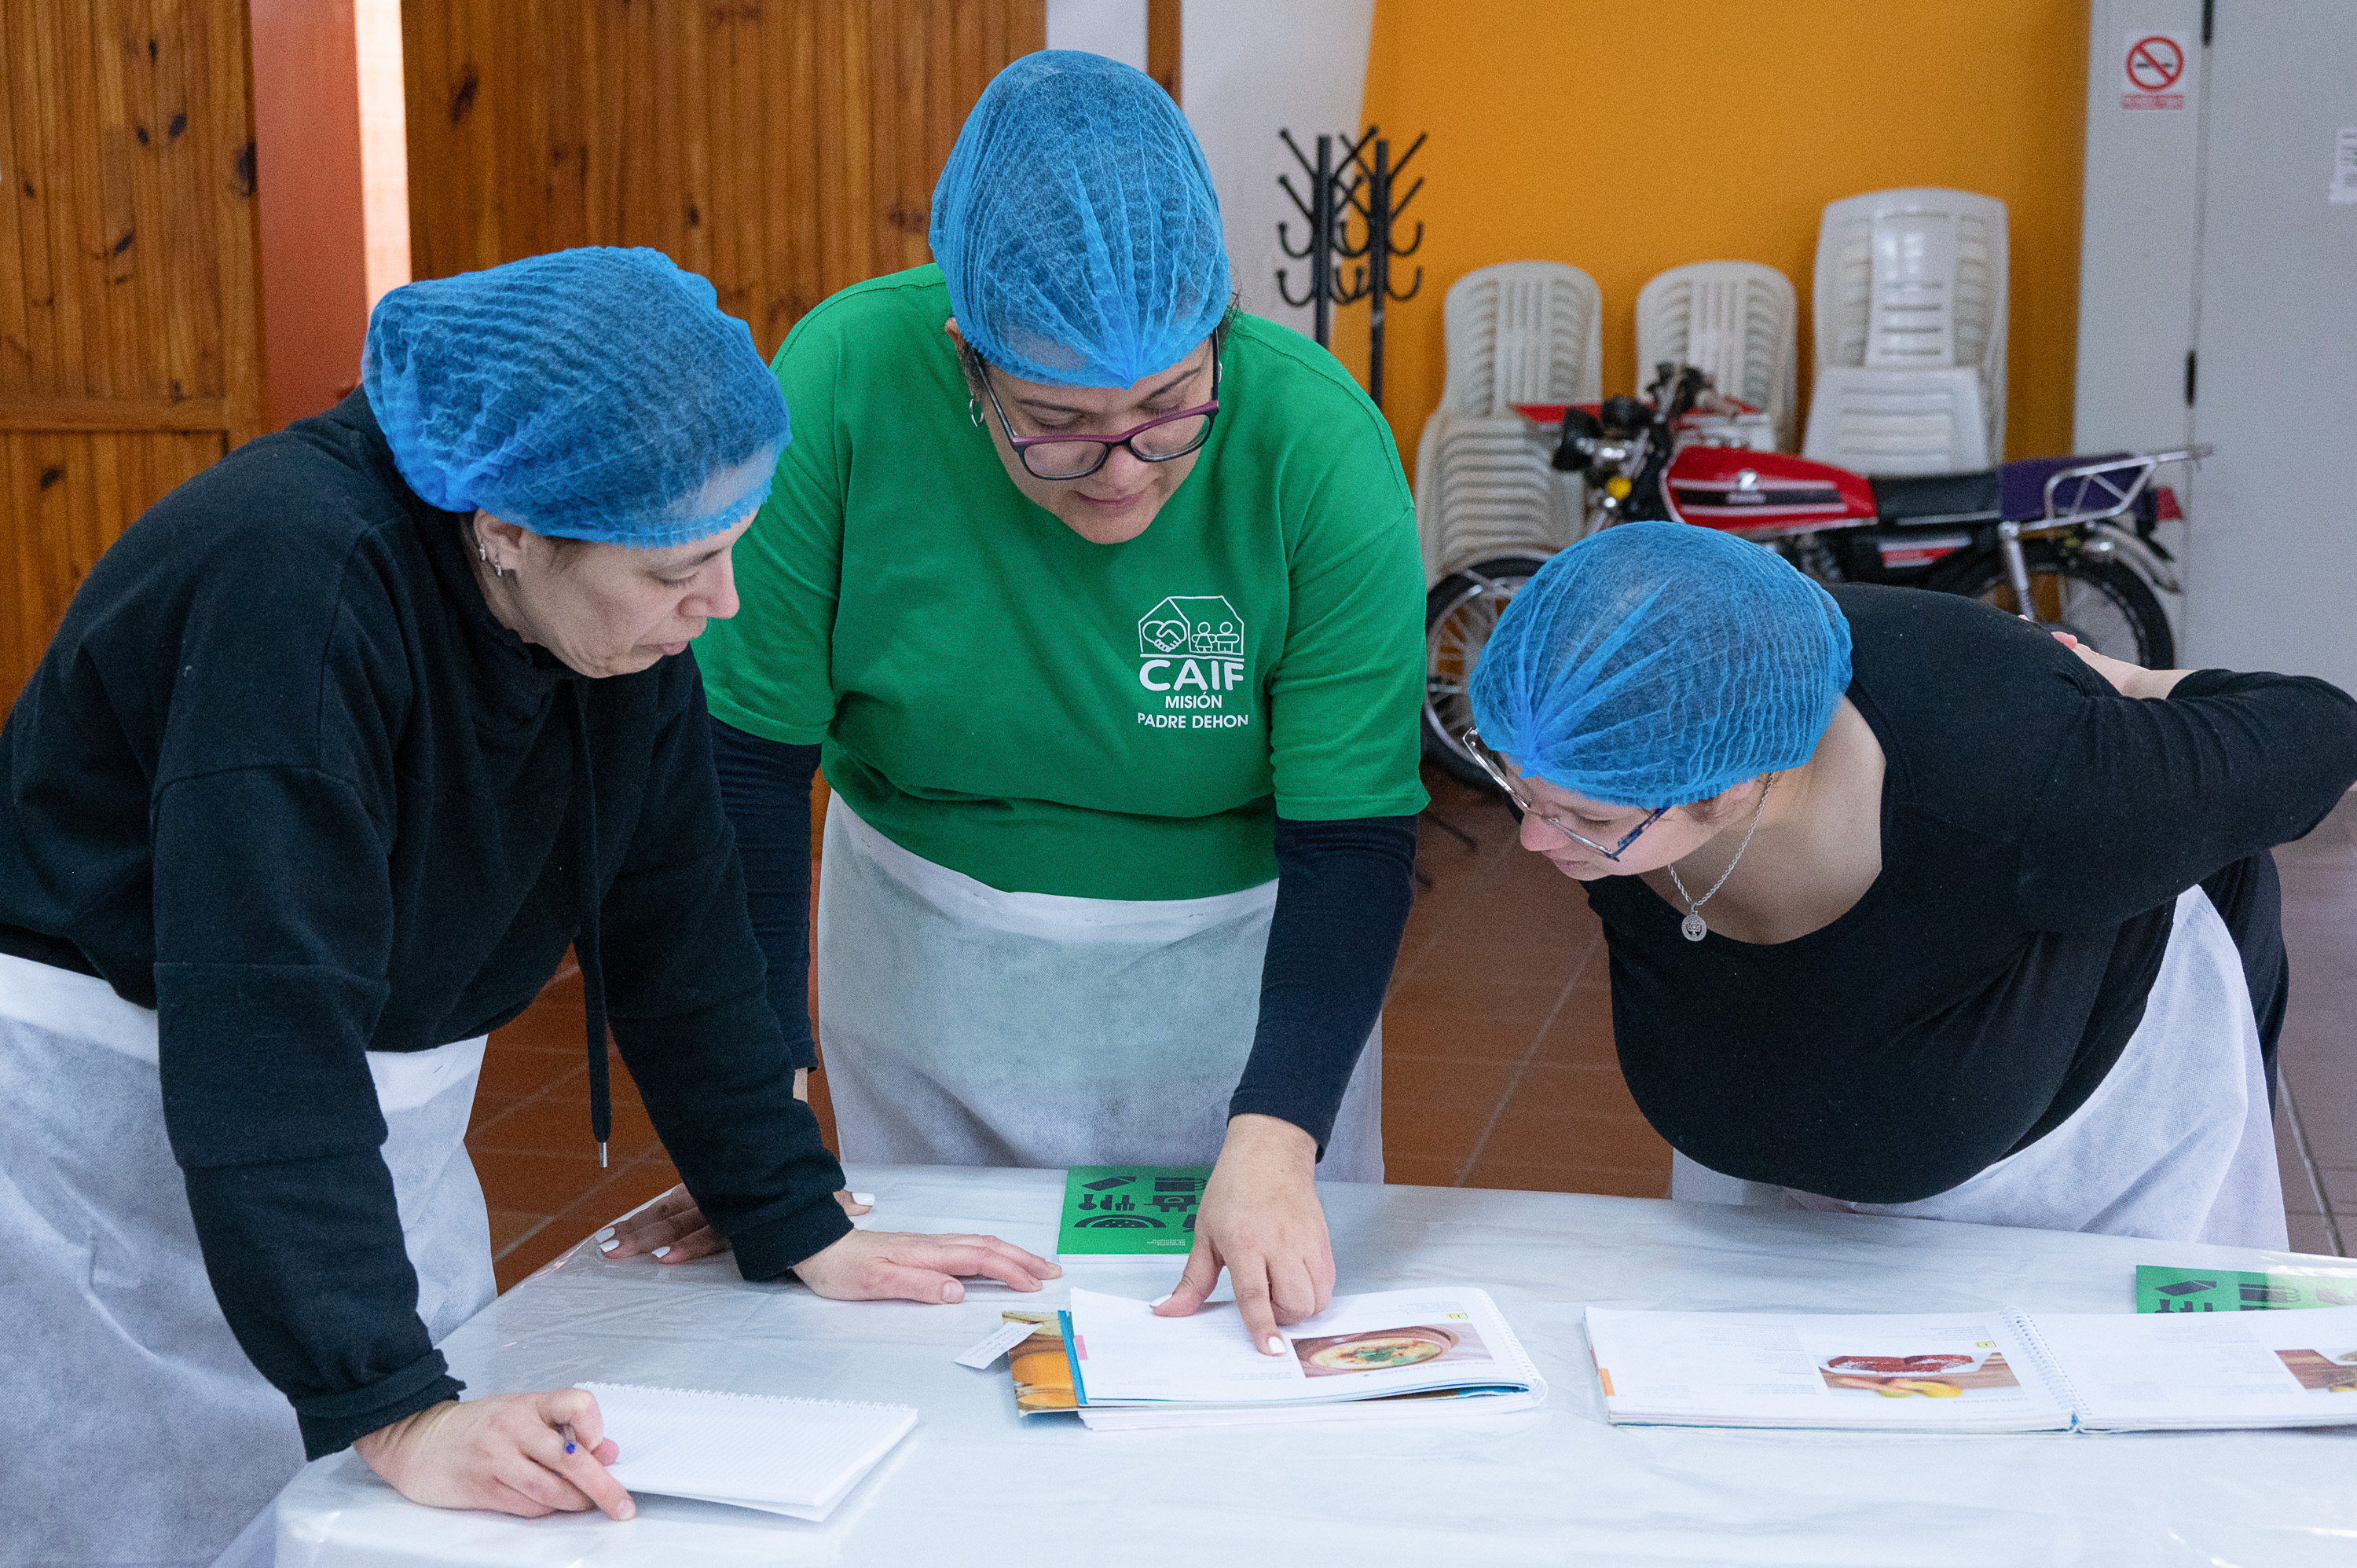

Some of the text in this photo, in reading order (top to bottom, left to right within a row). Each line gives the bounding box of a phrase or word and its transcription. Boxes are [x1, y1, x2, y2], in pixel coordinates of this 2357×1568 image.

[1139, 659, 1244, 691] CAIF
[1165, 691, 1222, 709] MISIÓN
[1138, 713, 1248, 728] PADRE DEHON
